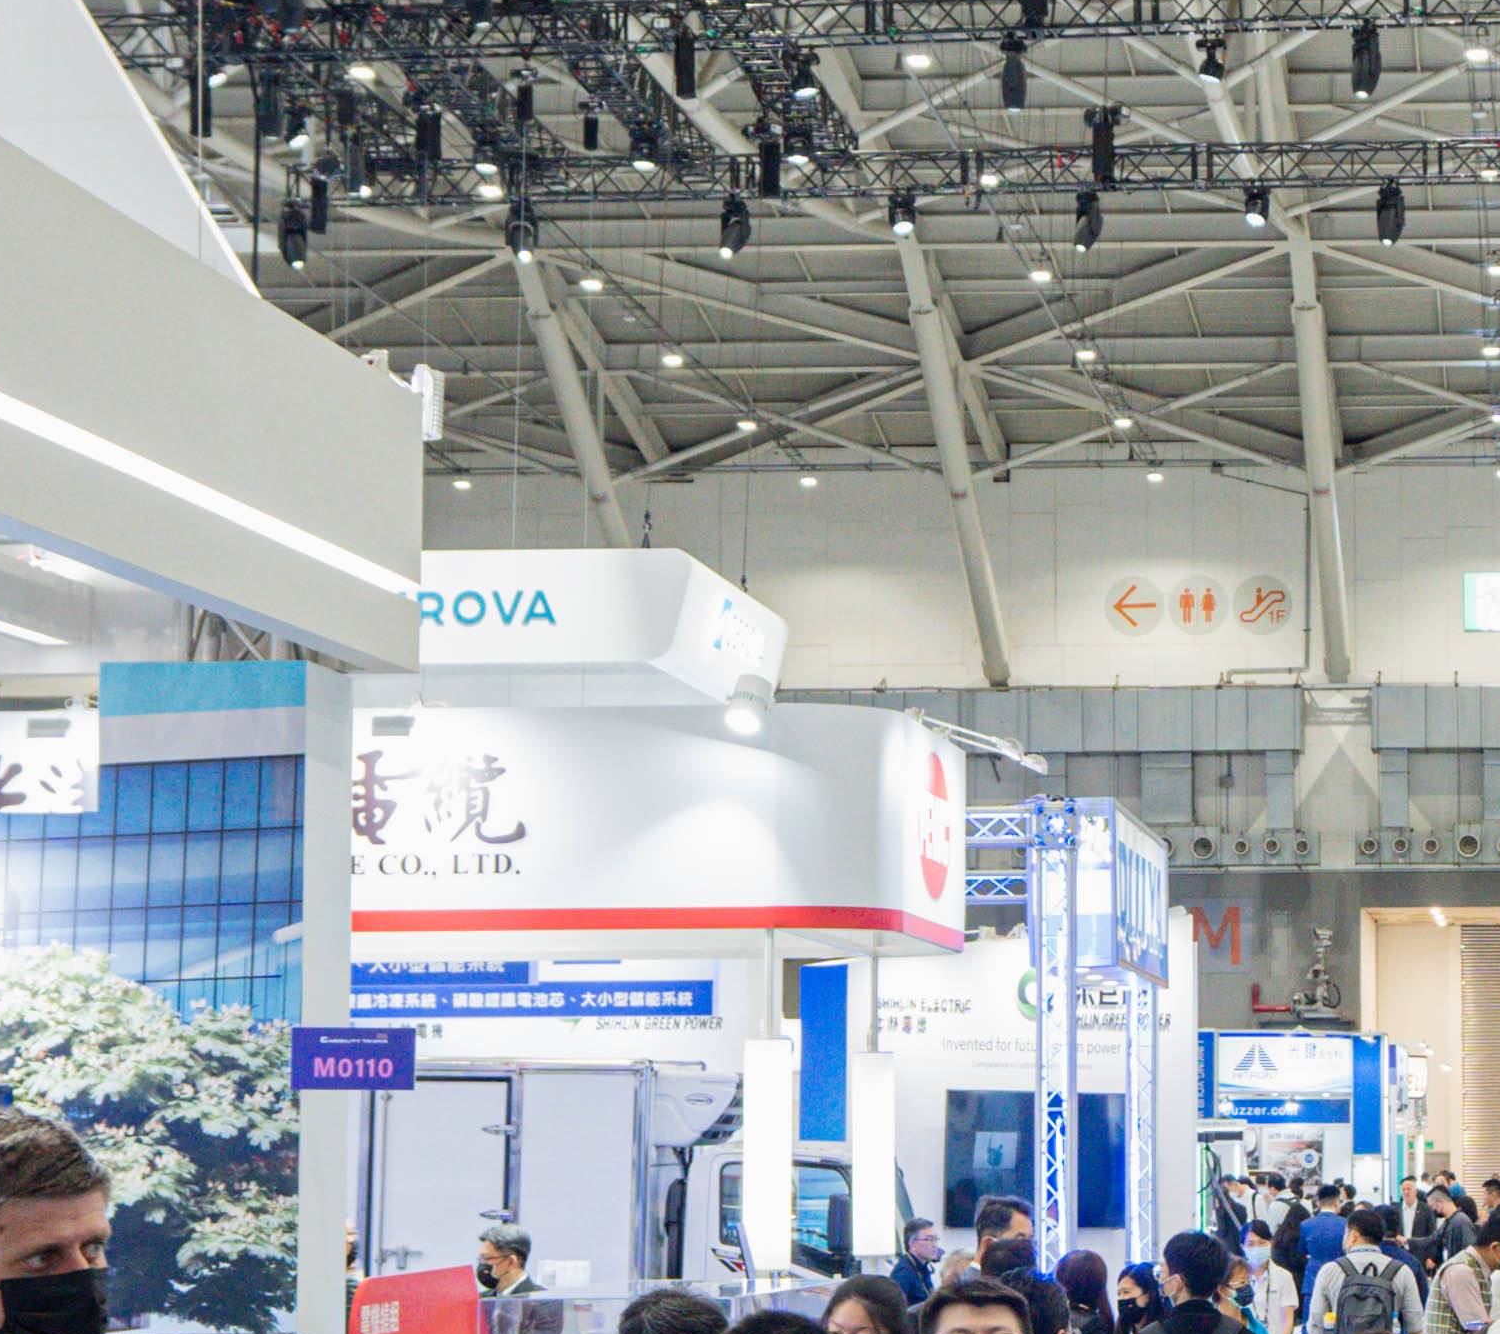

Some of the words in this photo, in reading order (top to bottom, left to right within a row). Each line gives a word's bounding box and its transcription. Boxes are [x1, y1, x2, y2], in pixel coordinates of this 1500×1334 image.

[402, 590, 557, 626] ROVA
[1269, 610, 1286, 624] 1F
[378, 853, 439, 880] CO.,
[452, 851, 522, 875] LTD.
[644, 1016, 680, 1030] GREEN
[683, 1016, 724, 1030] POWER
[313, 1056, 394, 1078] M0110
